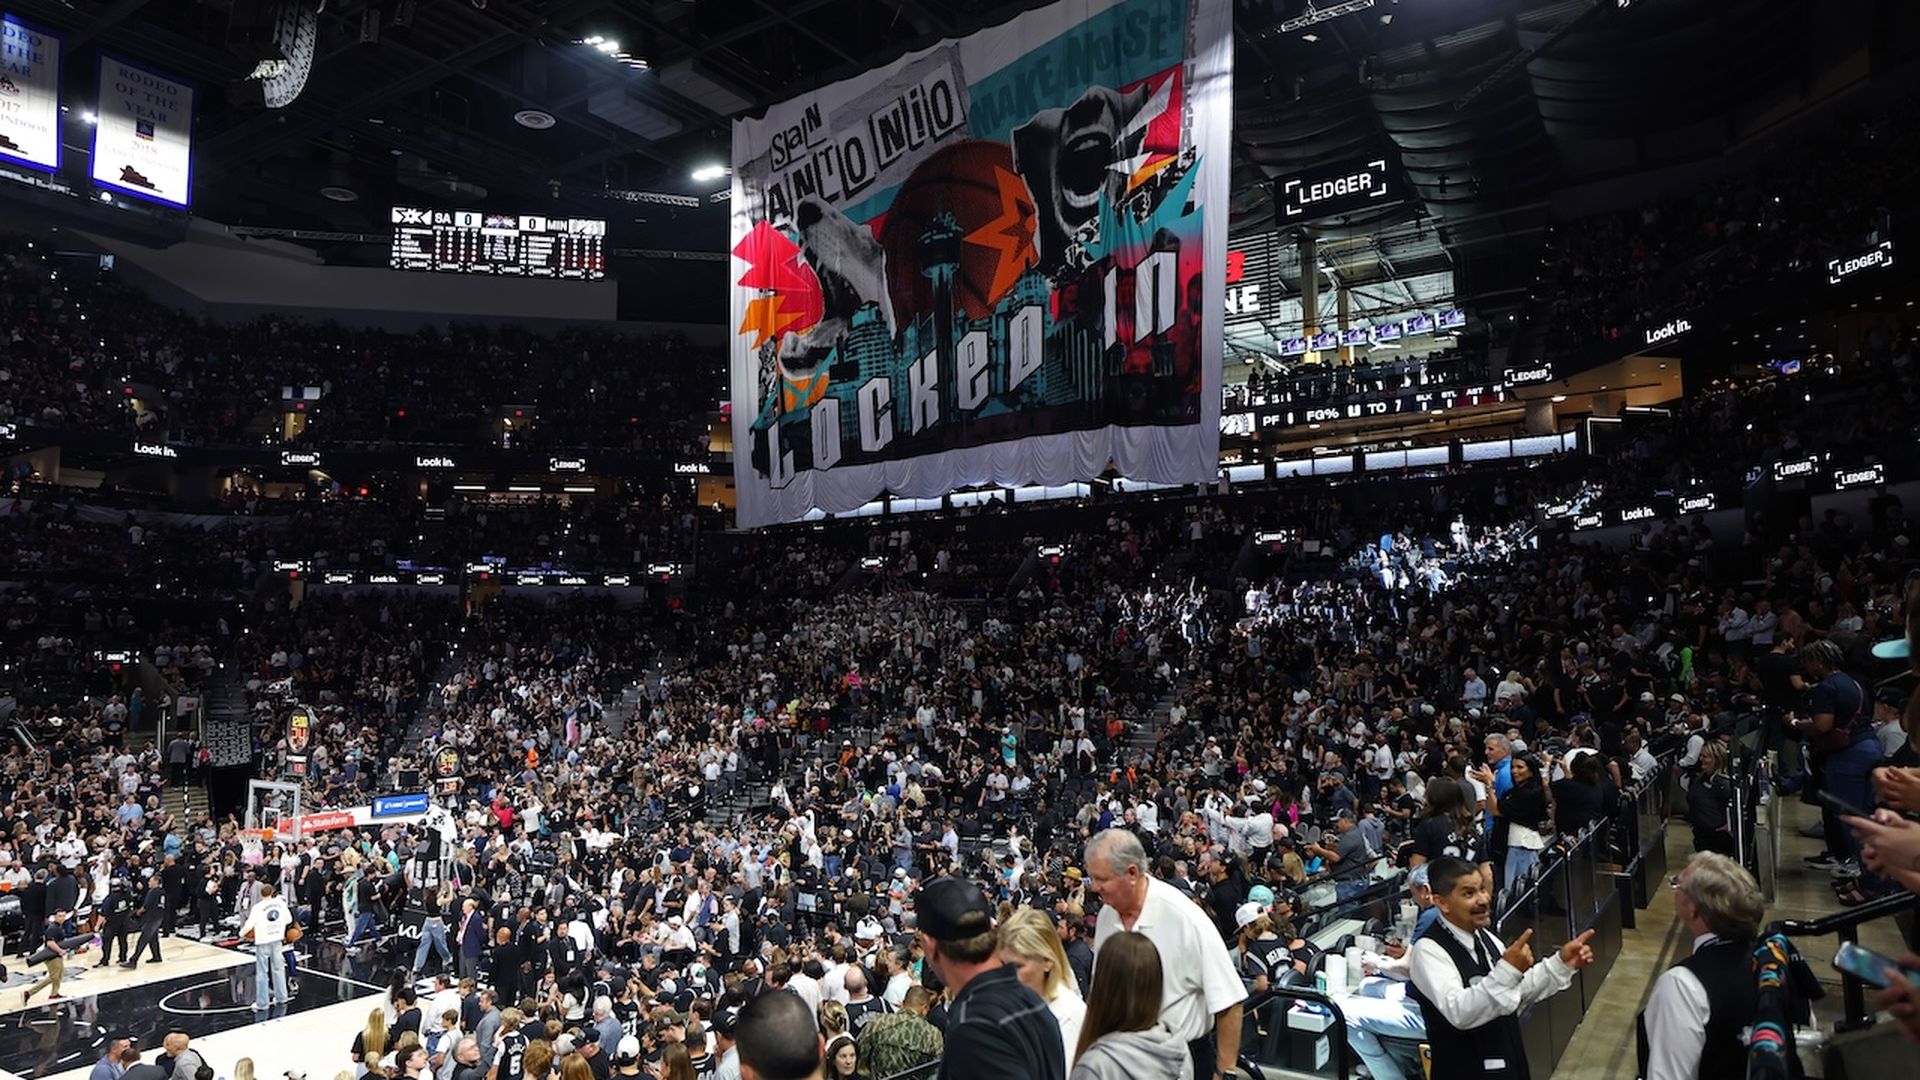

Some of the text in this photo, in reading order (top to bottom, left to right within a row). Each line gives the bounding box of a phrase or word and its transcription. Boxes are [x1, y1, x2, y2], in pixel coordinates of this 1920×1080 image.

[3, 42, 45, 66] THE
[119, 69, 178, 97] RODEO
[115, 82, 179, 112] OF THE
[124, 100, 168, 125] YEAR
[1299, 173, 1372, 204] LEDGER
[435, 212, 452, 225] SA
[465, 213, 473, 226] 0
[528, 217, 537, 231] 0
[547, 220, 568, 232] MIN
[1837, 250, 1883, 276] LEDGER
[1646, 318, 1692, 344] Lock in.
[1511, 369, 1548, 382] LEDGER
[1262, 415, 1280, 427] PF
[1306, 408, 1340, 422] FG%
[1367, 403, 1387, 415] TO
[134, 442, 177, 457] Lock in.
[287, 454, 315, 462] LEDGER
[416, 457, 455, 467] Lock in.
[555, 461, 581, 469] LEDGER
[675, 463, 710, 473] Lock in.
[1780, 461, 1812, 475] LEDGER
[1841, 470, 1876, 484] LEDGER
[1684, 498, 1710, 509] LEDGER
[1621, 506, 1655, 521] Lock in.
[370, 575, 388, 583] Lock
